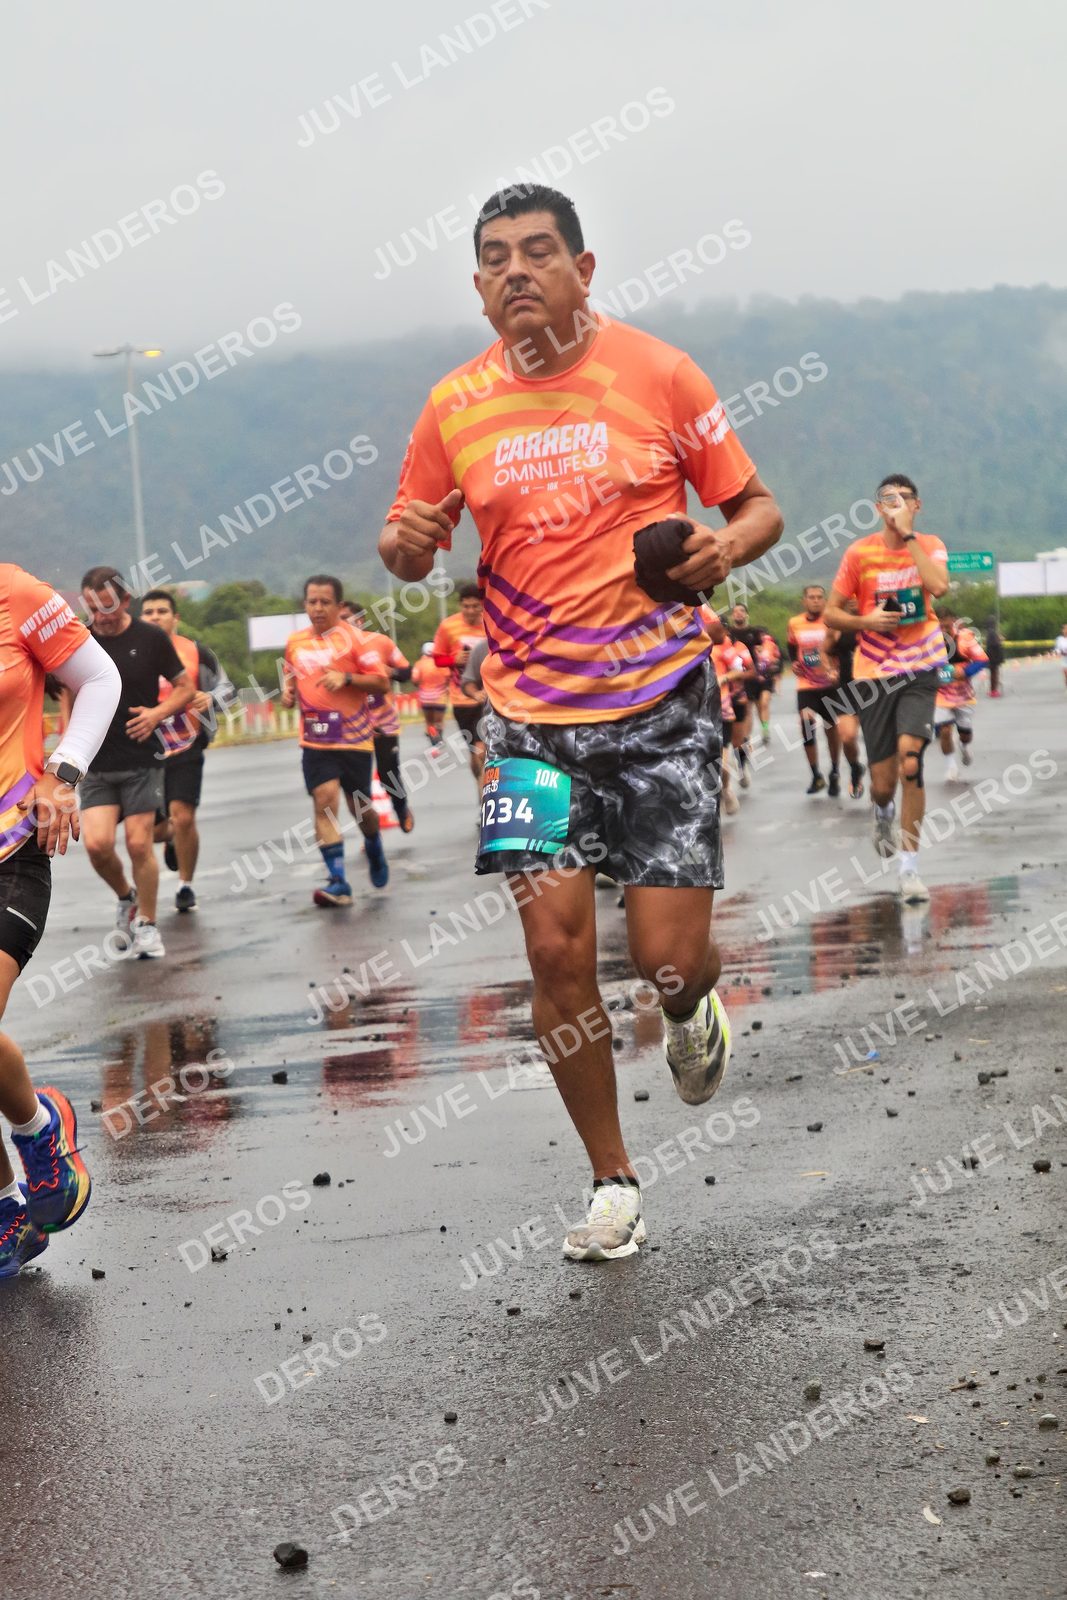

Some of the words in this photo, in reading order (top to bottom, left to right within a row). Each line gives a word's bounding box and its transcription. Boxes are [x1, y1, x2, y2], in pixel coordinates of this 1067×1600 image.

[494, 421, 609, 467] CARRERA
[494, 454, 582, 486] OMNILIFE
[535, 768, 561, 789] 10K
[481, 798, 534, 828] 1234
